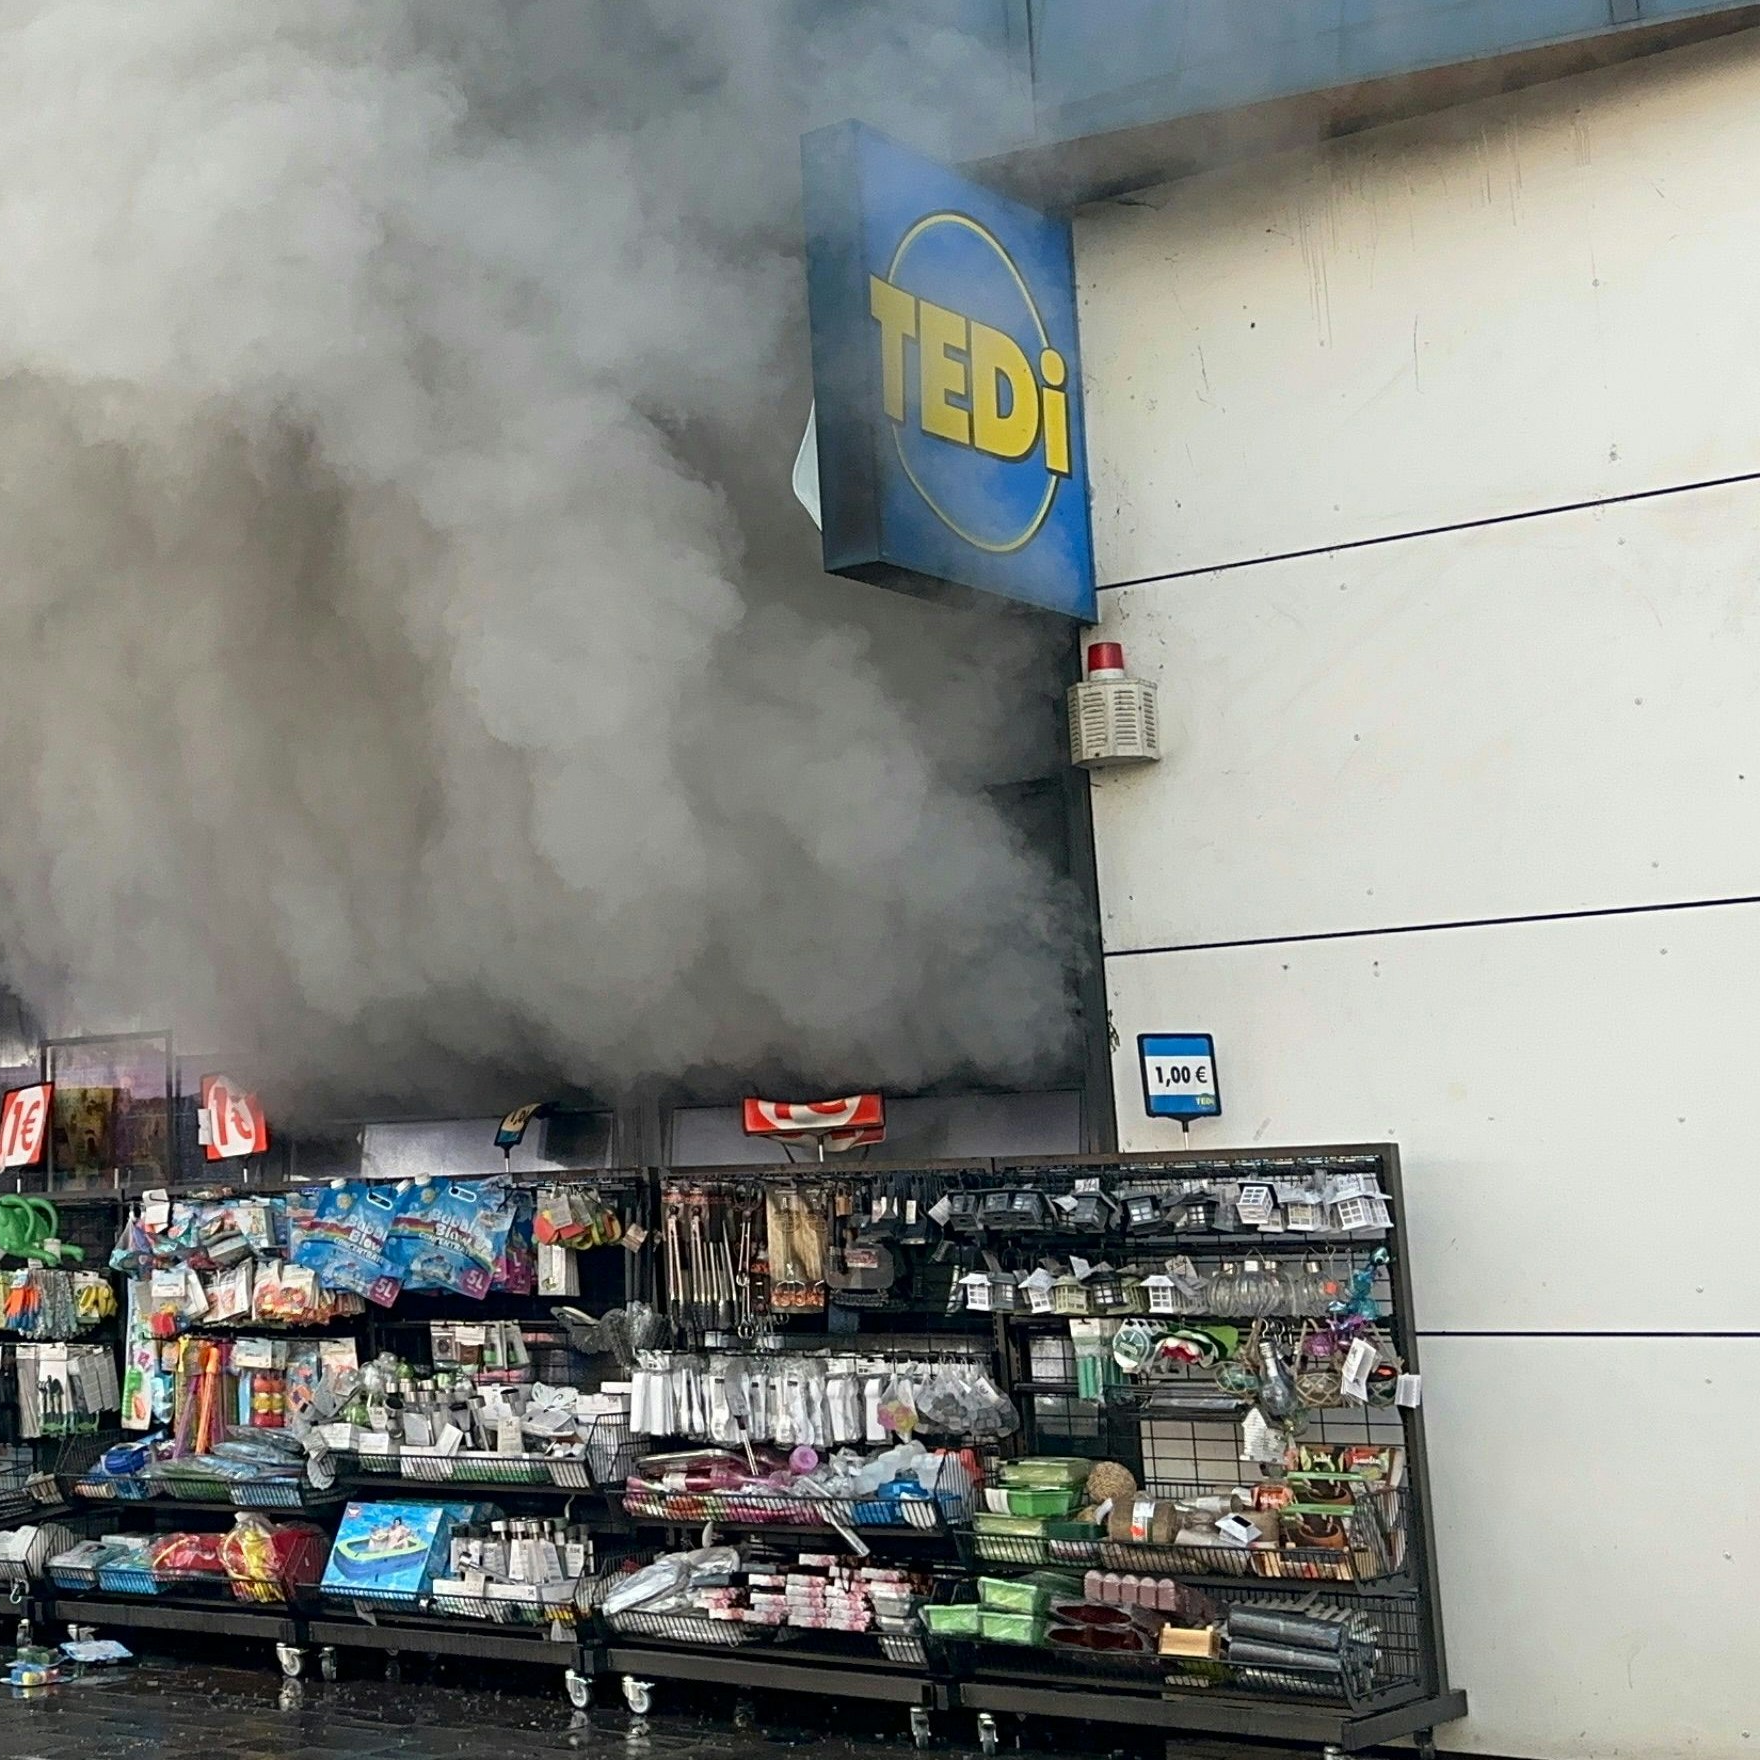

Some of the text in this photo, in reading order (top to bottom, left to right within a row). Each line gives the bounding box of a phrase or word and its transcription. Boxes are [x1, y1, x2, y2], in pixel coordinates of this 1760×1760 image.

[869, 272, 1073, 480] TEDi
[1155, 1065, 1208, 1088] 1,00 €
[7, 1100, 41, 1157] 1€
